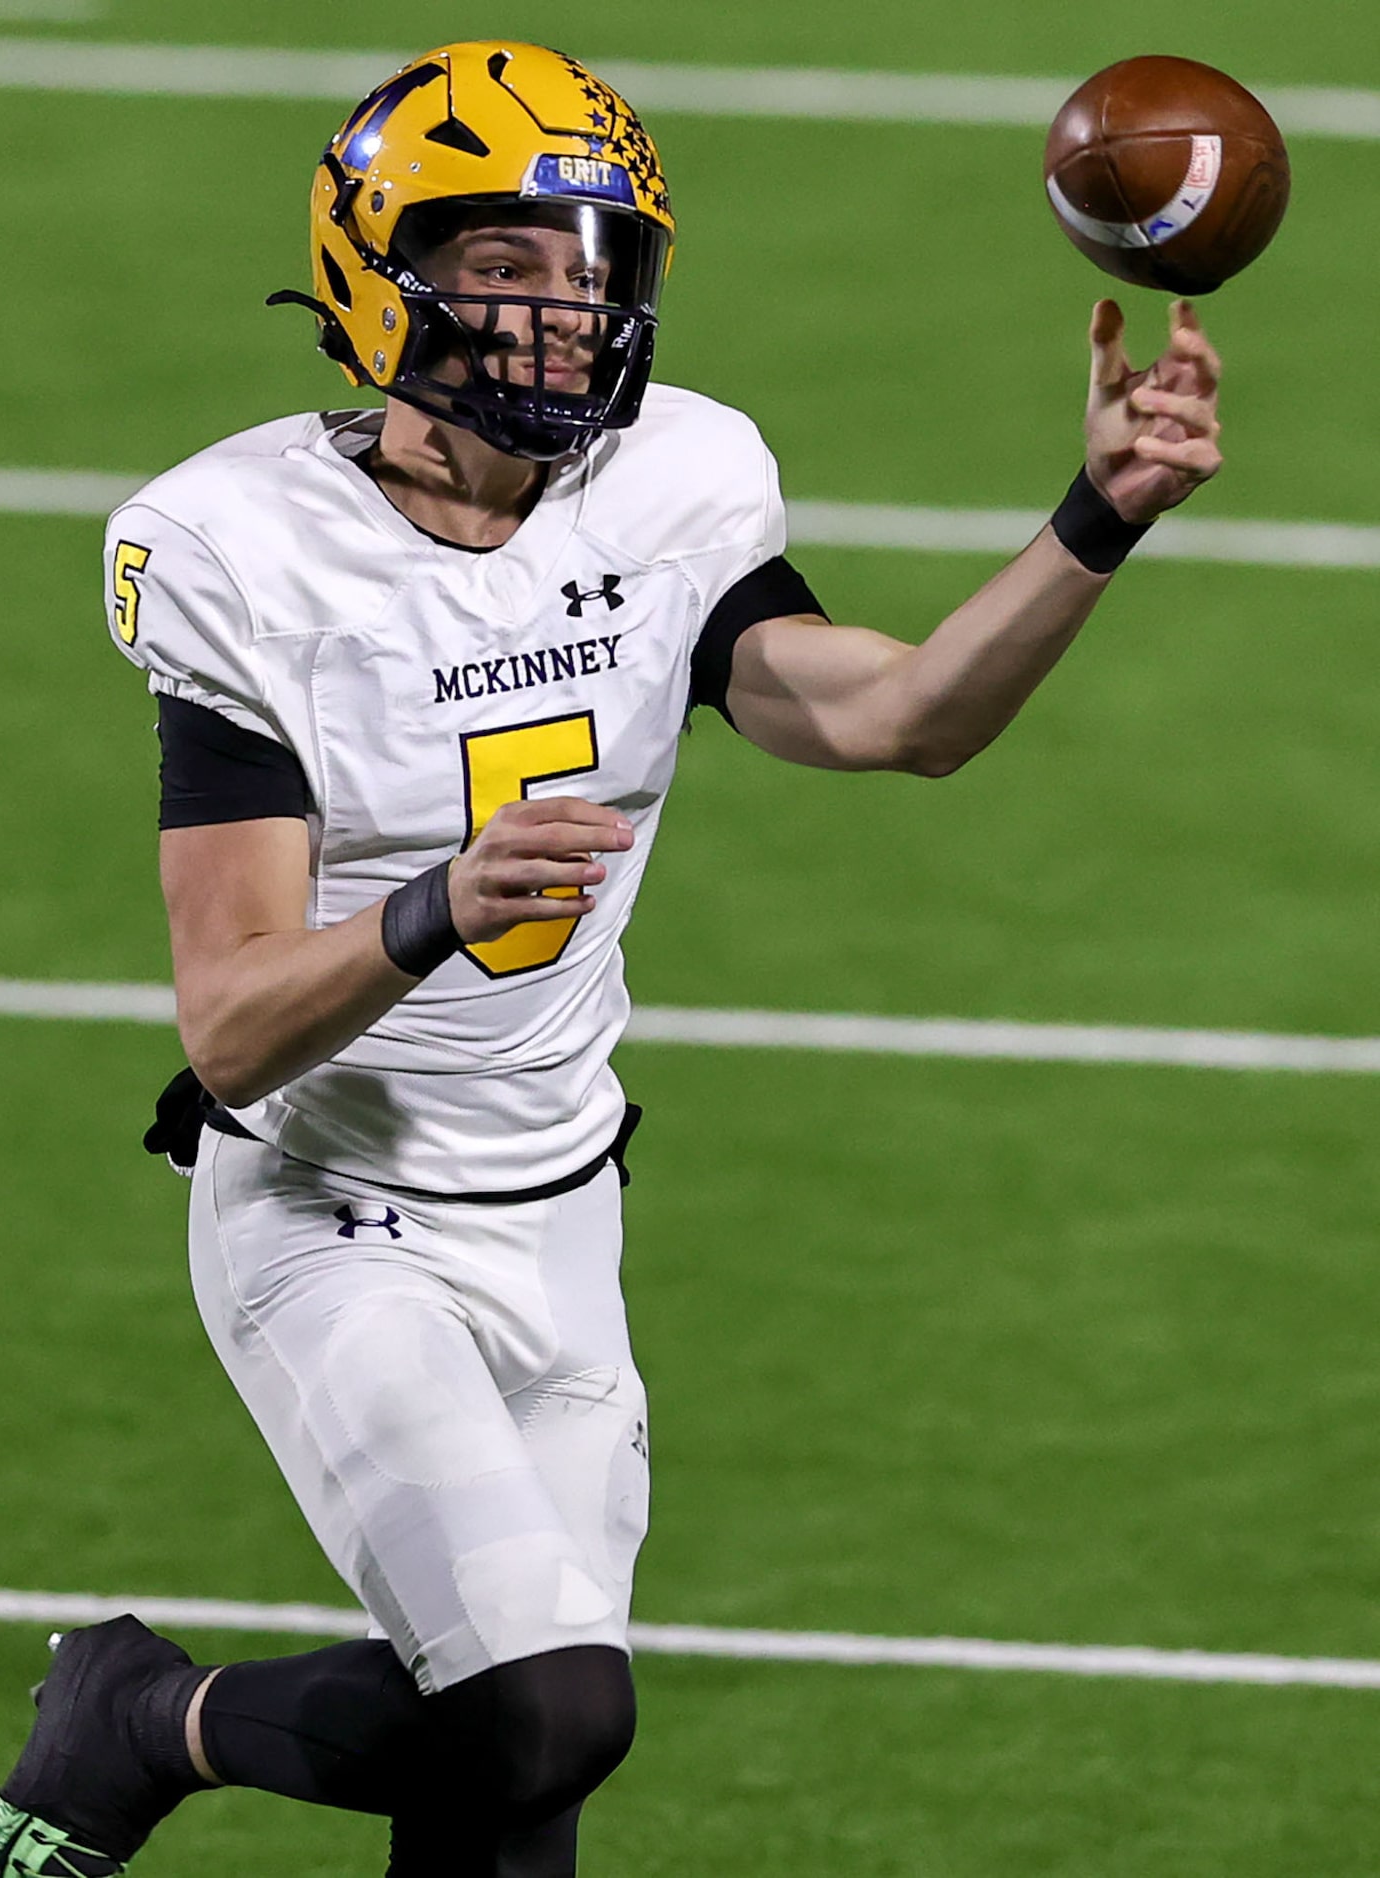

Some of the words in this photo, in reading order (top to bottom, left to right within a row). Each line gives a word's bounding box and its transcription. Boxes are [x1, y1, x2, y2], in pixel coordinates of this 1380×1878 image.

[558, 157, 612, 186] GRIT
[113, 539, 152, 647] 5
[433, 633, 623, 705] MCKINNEY
[459, 709, 598, 981] 5
